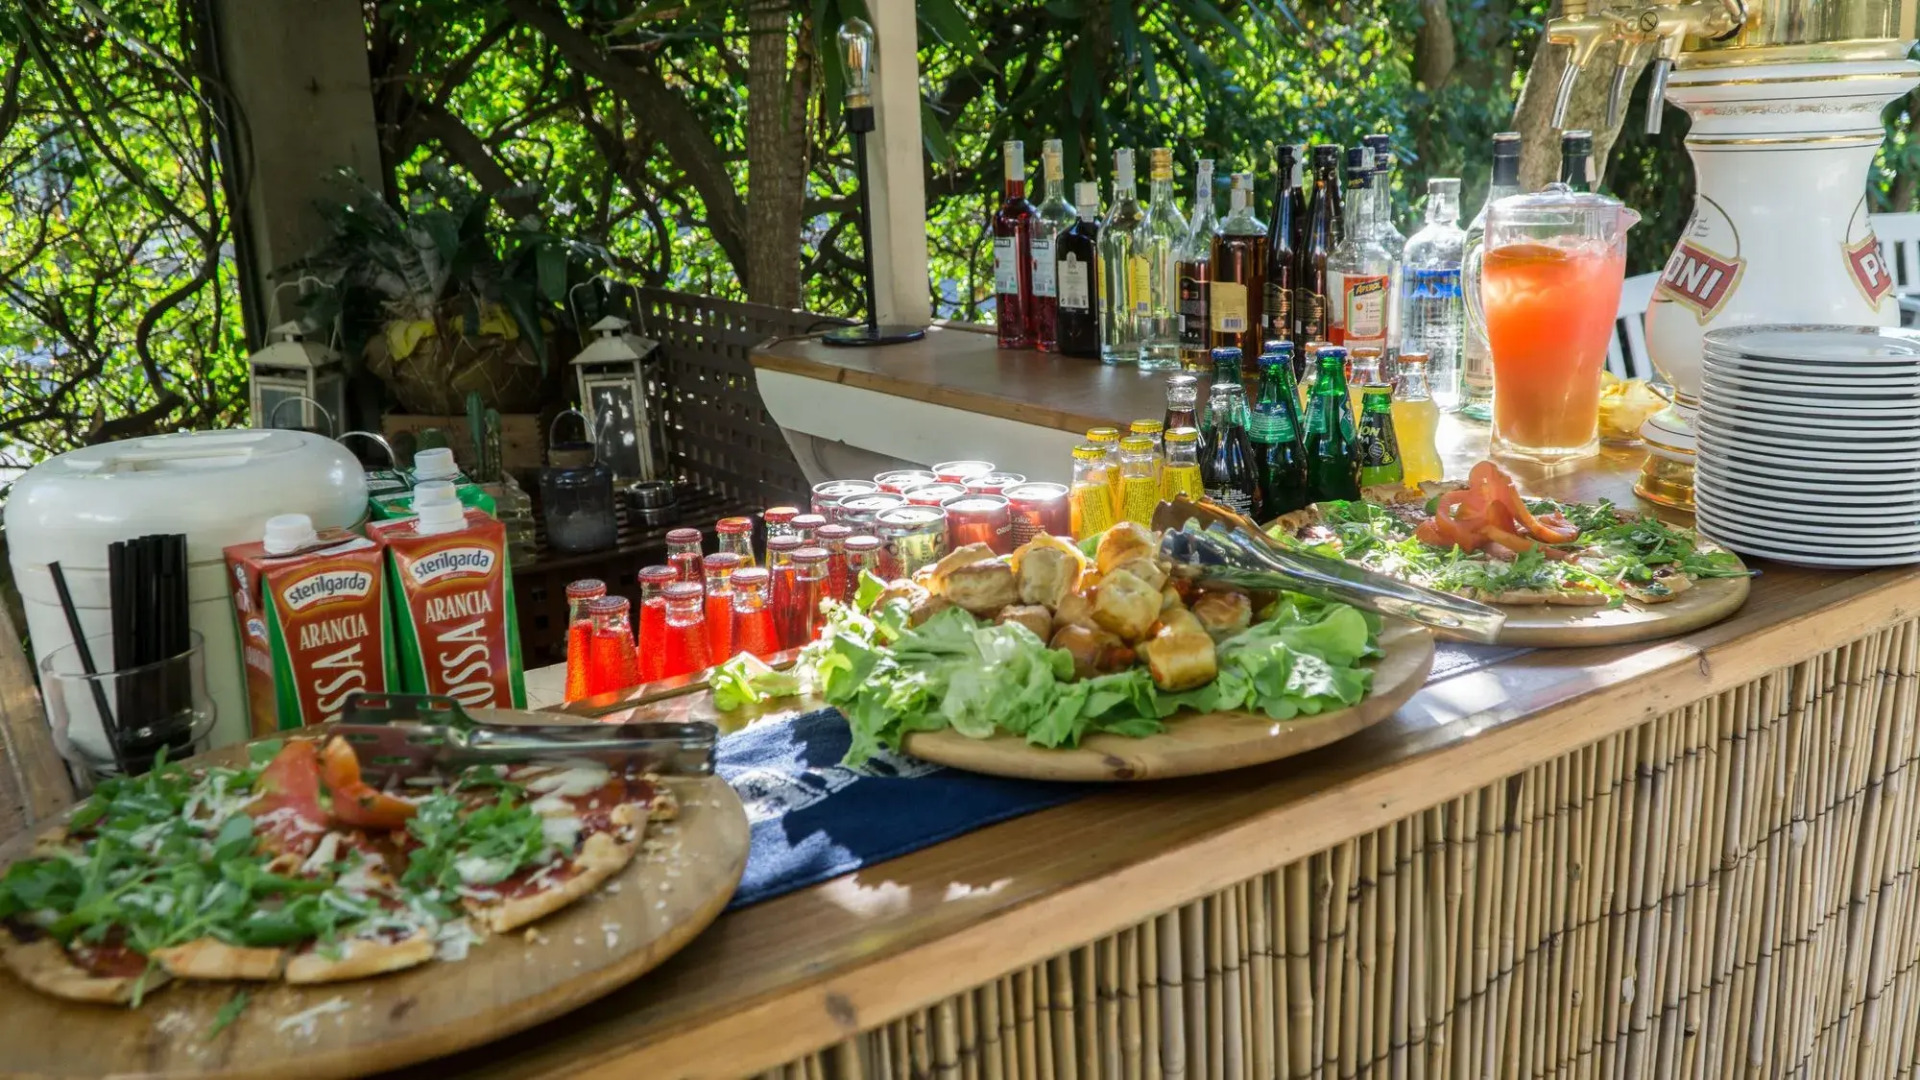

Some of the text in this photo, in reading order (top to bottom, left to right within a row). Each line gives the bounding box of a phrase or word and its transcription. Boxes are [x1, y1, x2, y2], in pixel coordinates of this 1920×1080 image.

[414, 550, 490, 578] sterilgarda
[289, 572, 367, 604] sterilgarda
[425, 589, 492, 623] ARANCIA
[299, 613, 369, 651] ARANCIA
[436, 618, 496, 709] OSSA
[311, 643, 367, 723] SSA
